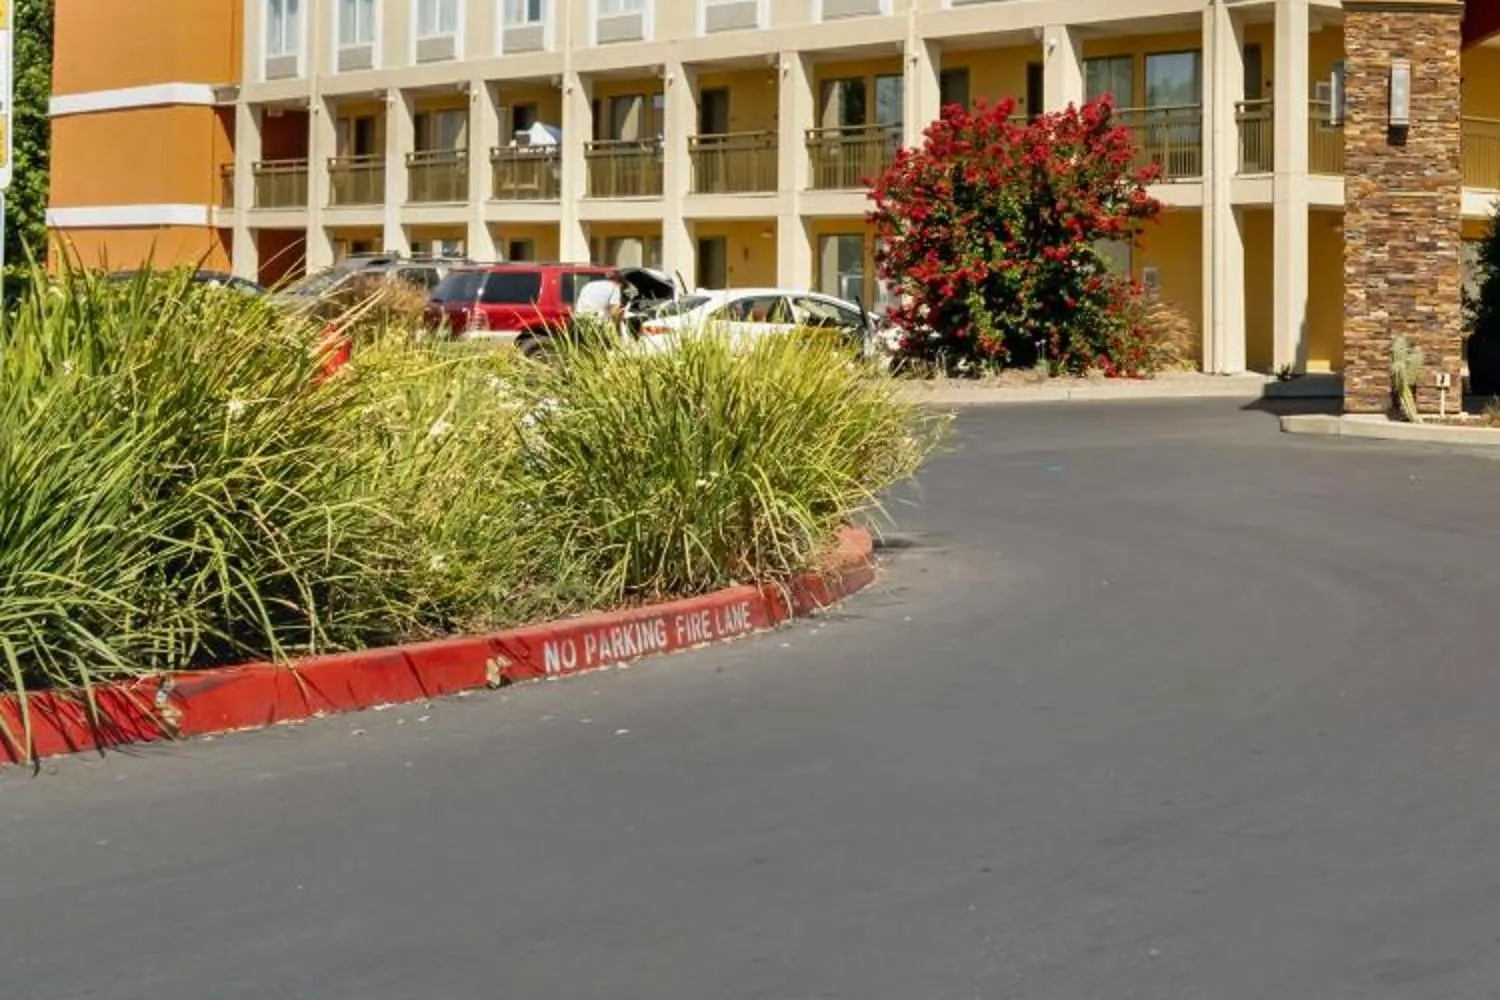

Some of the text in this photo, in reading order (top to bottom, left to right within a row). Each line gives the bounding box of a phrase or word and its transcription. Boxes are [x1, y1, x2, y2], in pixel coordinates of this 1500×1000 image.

[544, 602, 752, 673] NO PARKING FIRE LANE
